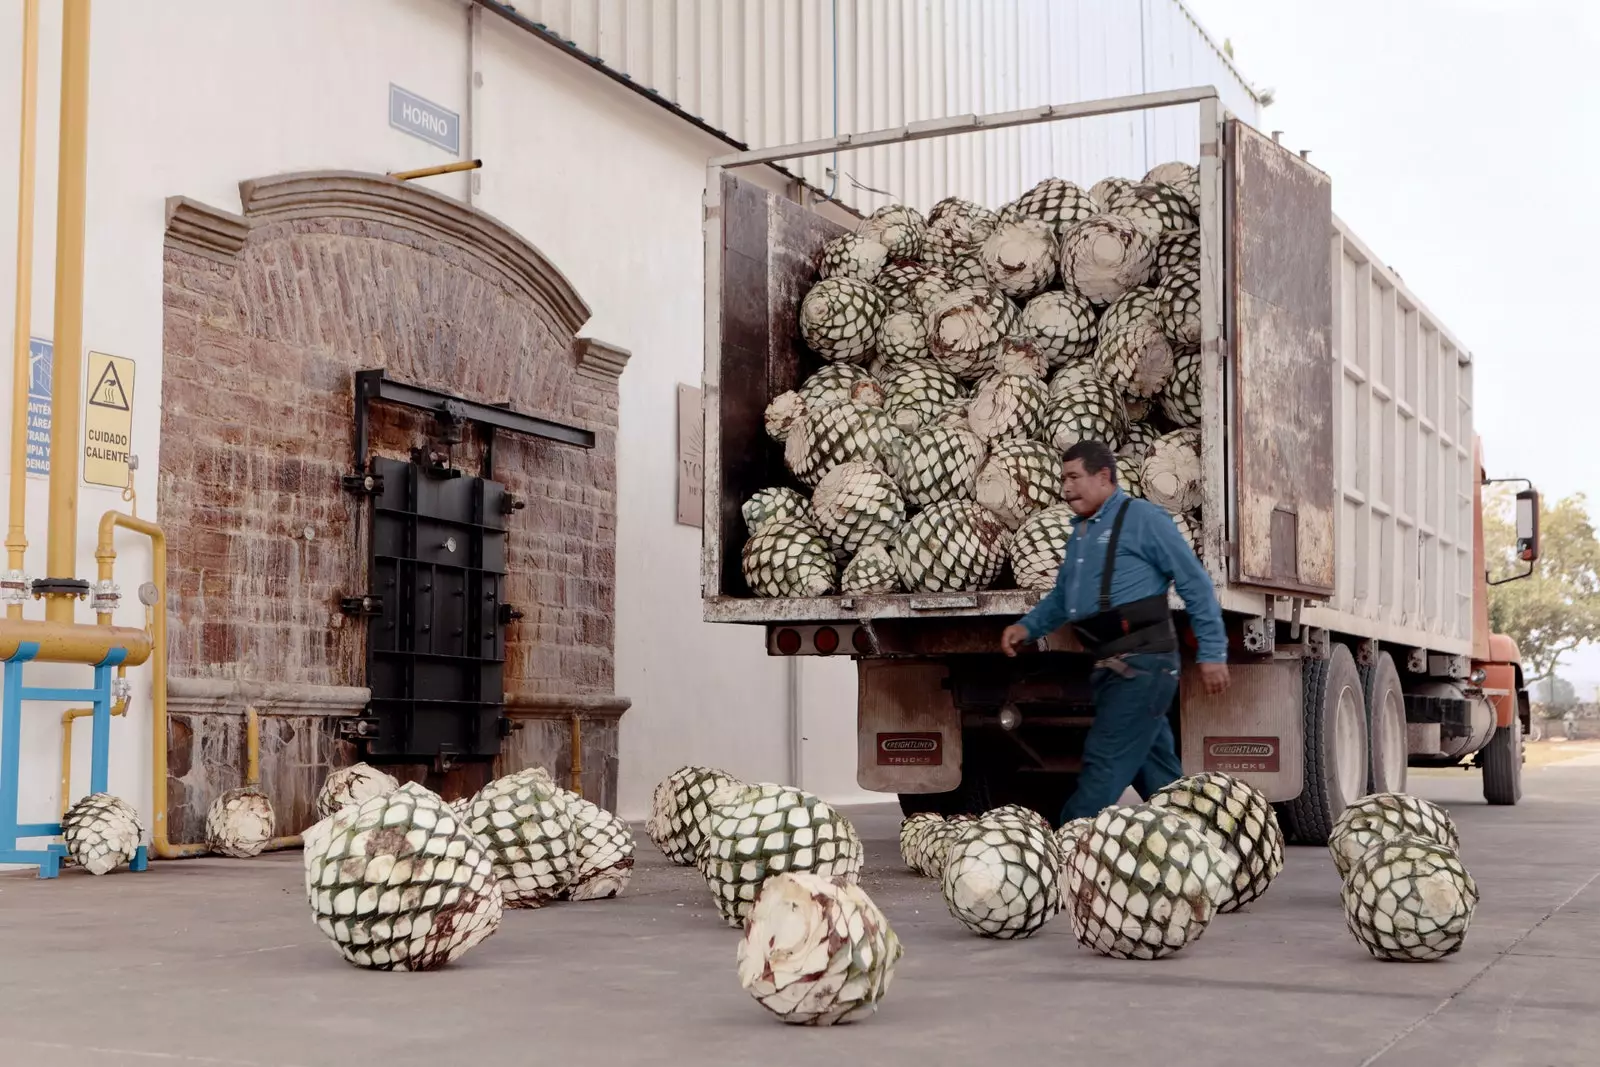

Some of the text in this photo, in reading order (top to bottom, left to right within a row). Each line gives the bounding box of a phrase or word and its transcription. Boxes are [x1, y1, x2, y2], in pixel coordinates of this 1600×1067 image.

[403, 101, 448, 137] HORNO
[88, 429, 128, 446] CUIDADO
[86, 446, 128, 464] CALIENTE
[886, 740, 934, 749] FREIGHTLINER
[1214, 744, 1269, 754] FREIGHTLINER
